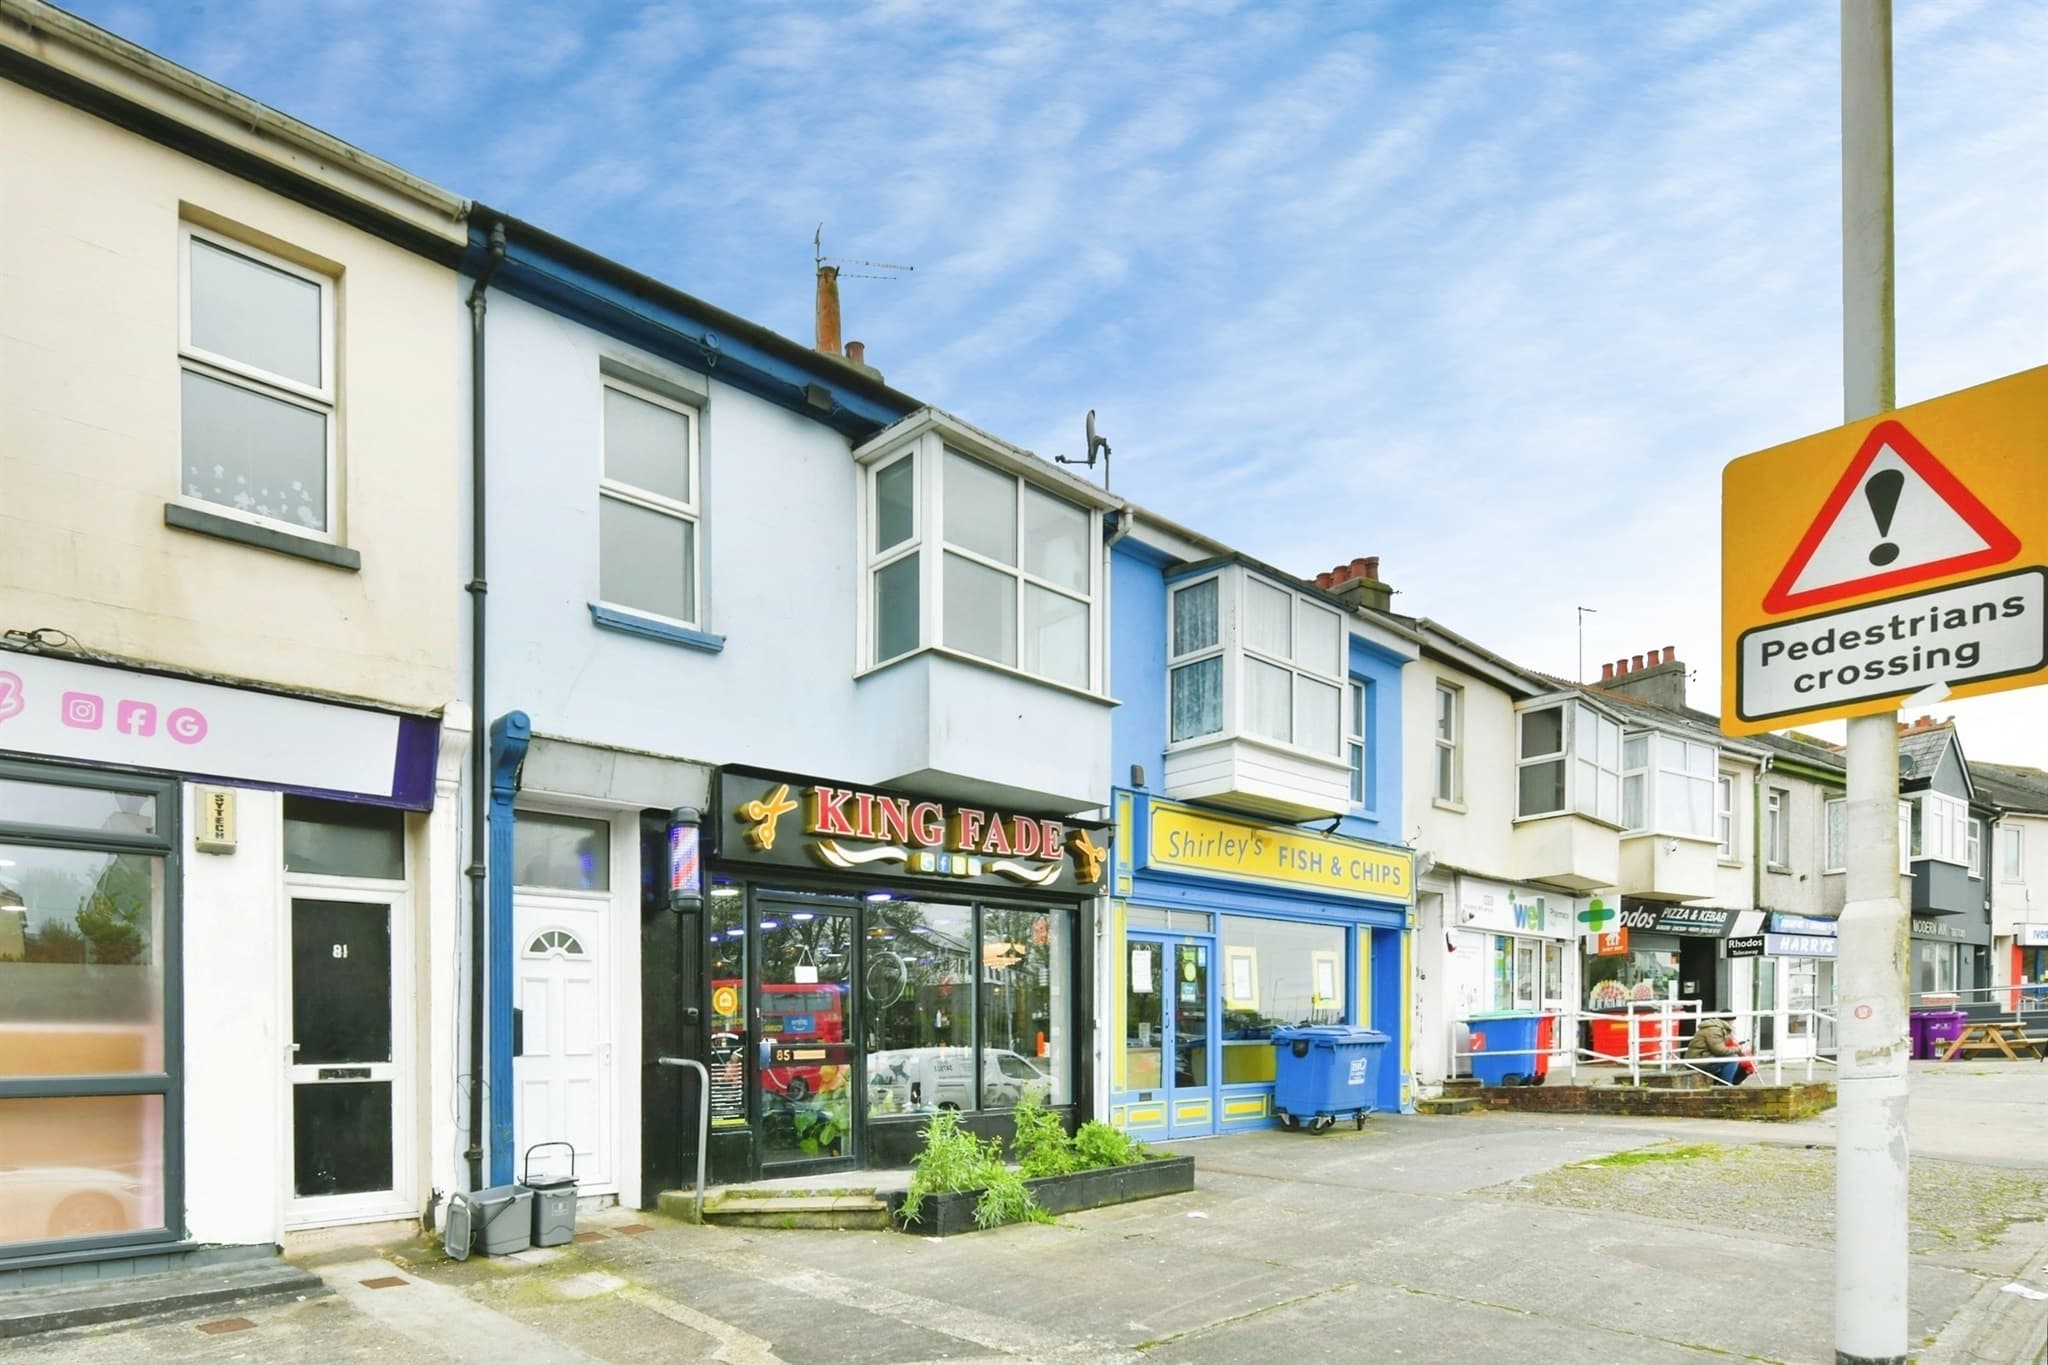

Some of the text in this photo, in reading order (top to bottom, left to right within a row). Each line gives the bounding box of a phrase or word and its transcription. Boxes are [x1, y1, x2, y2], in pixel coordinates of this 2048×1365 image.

[1761, 596, 2025, 667] Pedestrians
[1793, 640, 1980, 693] crossing
[214, 794, 225, 839] SYTECH
[814, 785, 1064, 860] KING FADE
[1168, 829, 1402, 886] Shirley's FISH & CHIPS
[1620, 905, 1656, 929] odos
[1661, 907, 1690, 920] PIZZA
[1690, 909, 1699, 921] &
[1698, 910, 1728, 922] KEBAB
[332, 944, 348, 958] 81
[1728, 938, 1762, 949] Rhodos
[776, 1049, 791, 1061] 85
